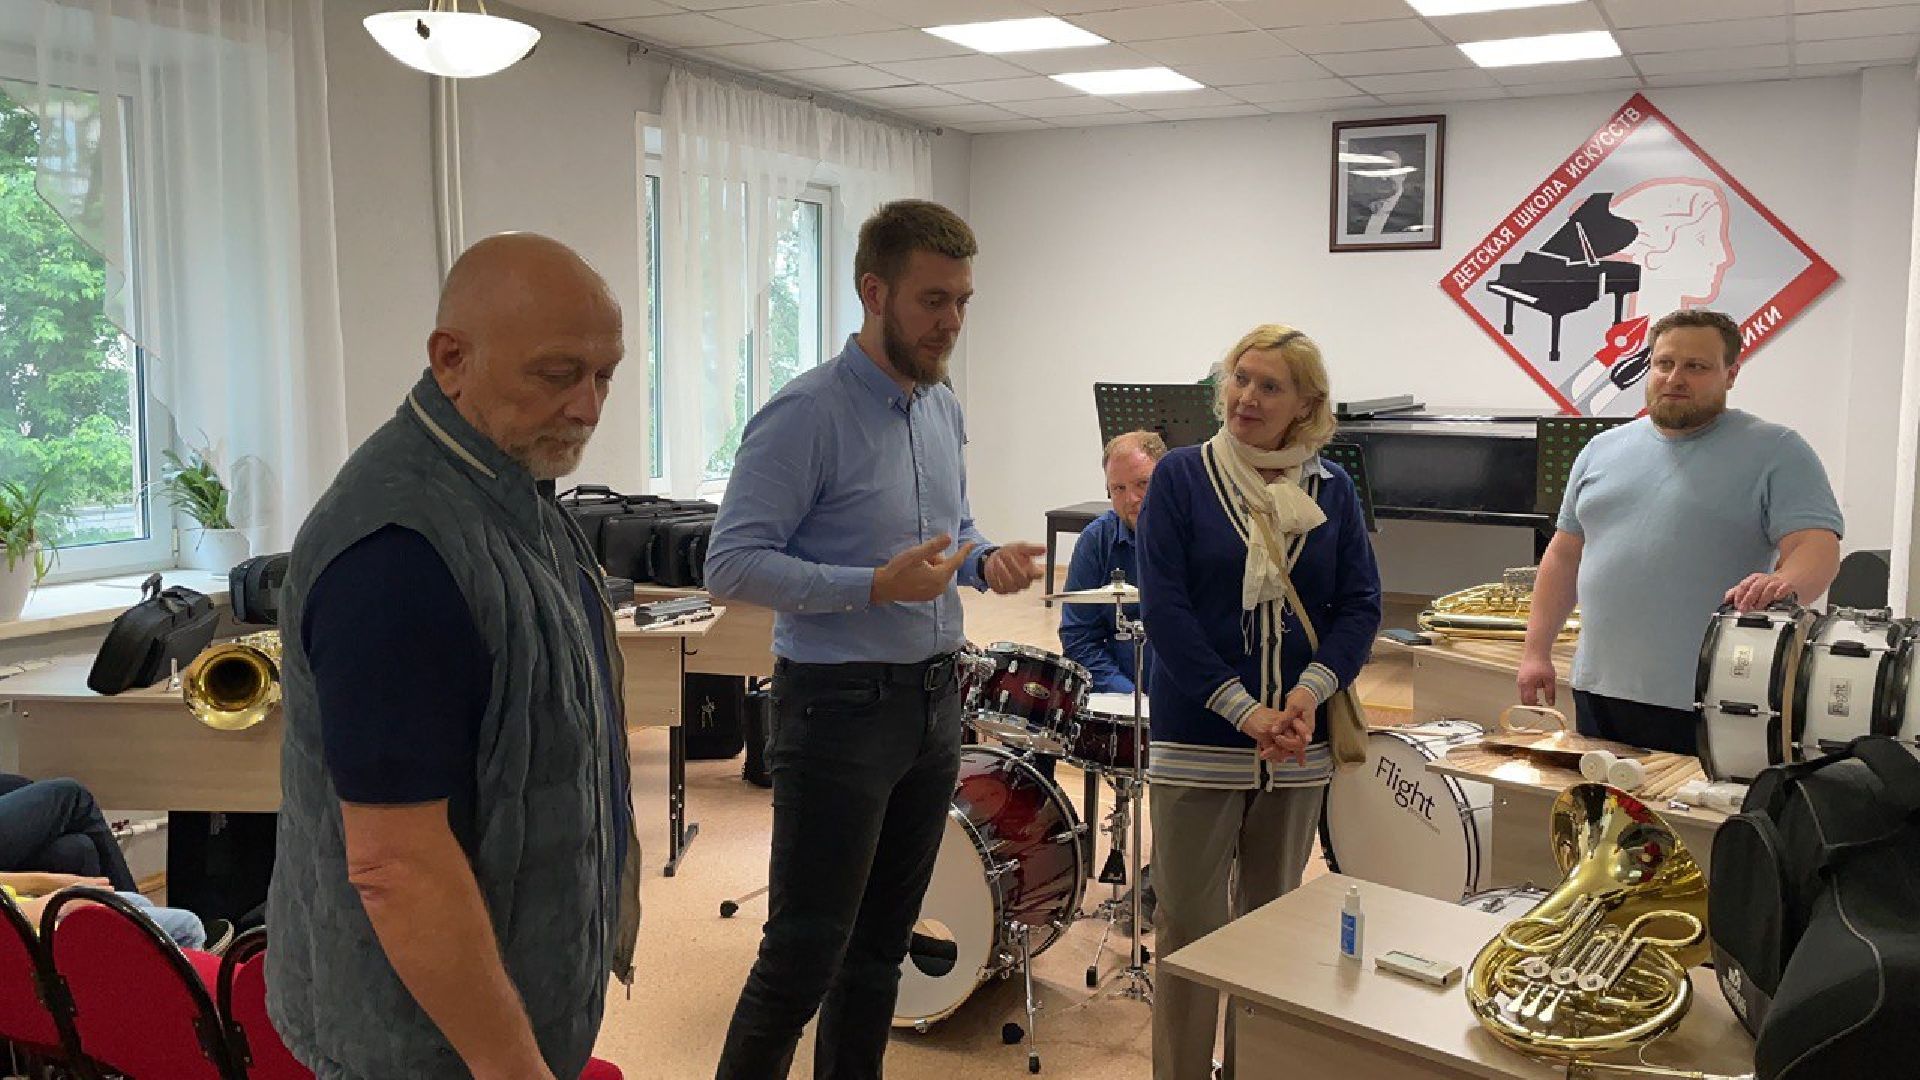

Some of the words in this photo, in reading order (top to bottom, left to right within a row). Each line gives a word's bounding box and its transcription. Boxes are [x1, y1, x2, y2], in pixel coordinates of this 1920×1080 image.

[1452, 226, 1516, 289] ДЕТСКАЯ
[1513, 179, 1567, 228] ШКОЛА
[1566, 107, 1641, 178] ИСКУССТВ
[1375, 756, 1435, 820] Flight
